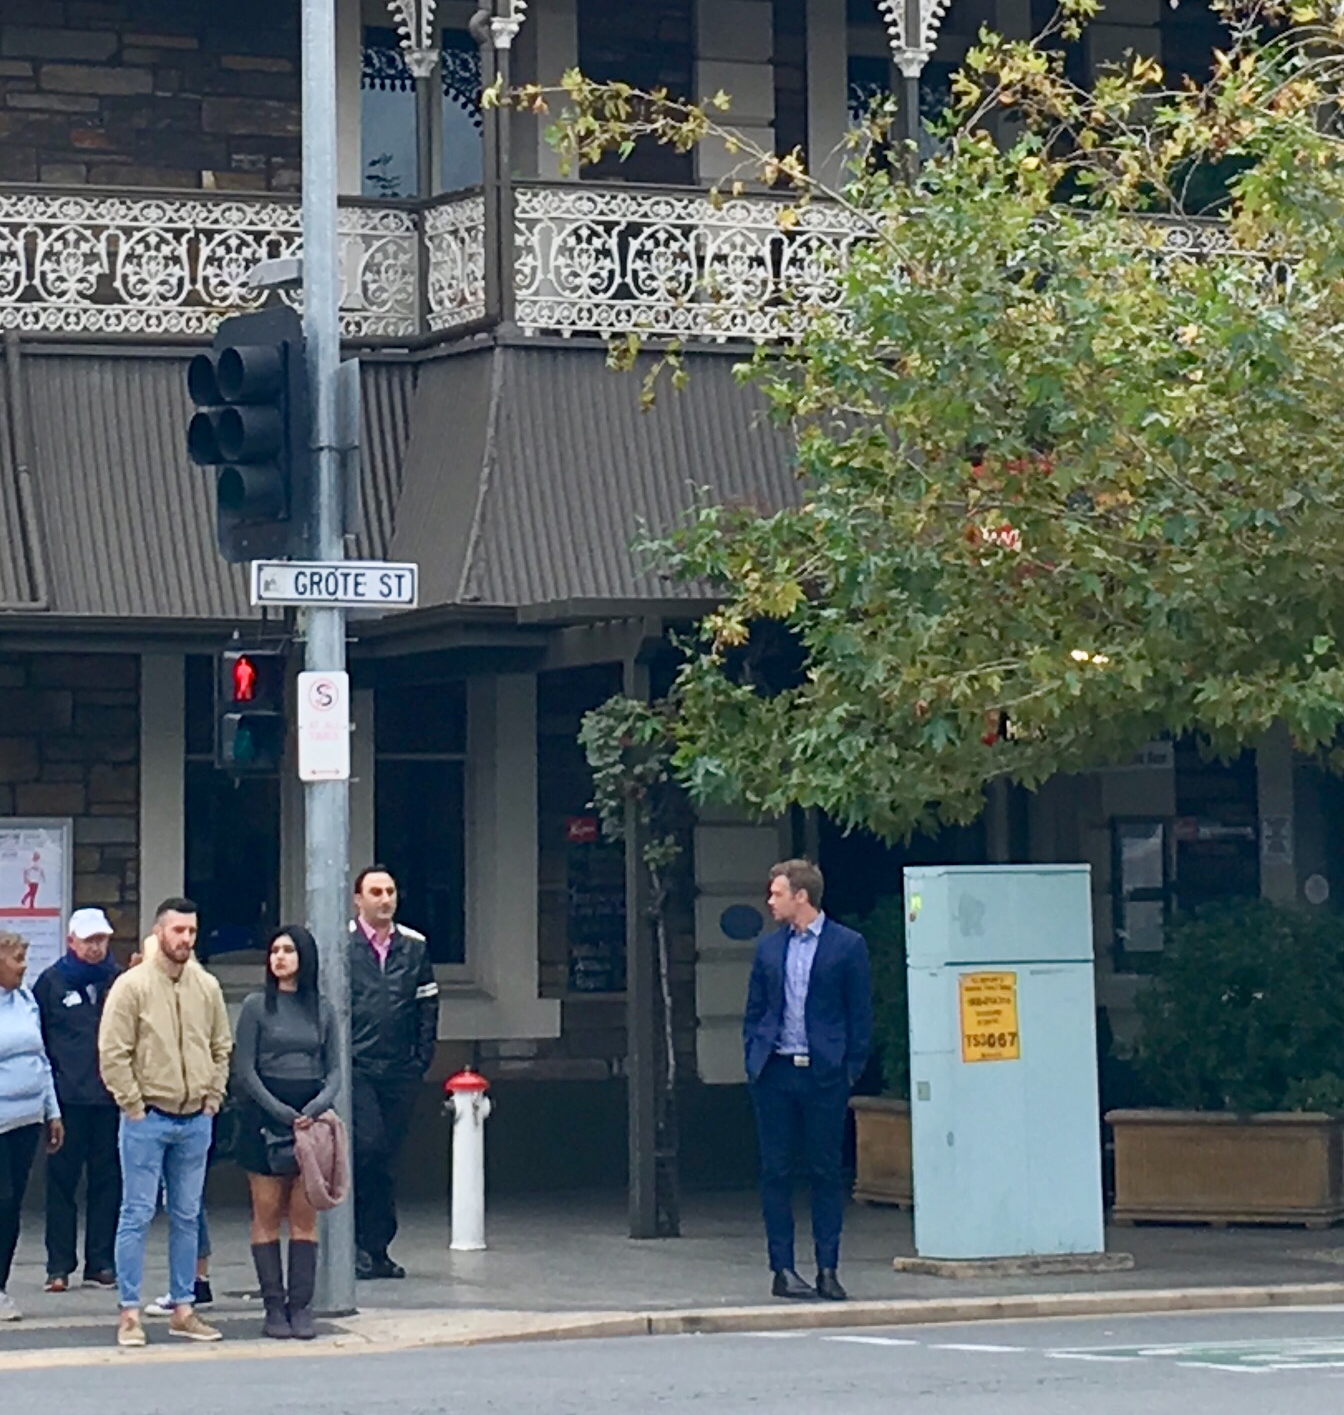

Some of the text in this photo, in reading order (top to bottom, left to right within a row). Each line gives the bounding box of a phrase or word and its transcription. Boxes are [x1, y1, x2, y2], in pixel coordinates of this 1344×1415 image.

[294, 571, 406, 598] GROTE ST
[316, 683, 333, 707] S
[965, 1032, 1017, 1048] TS3067
